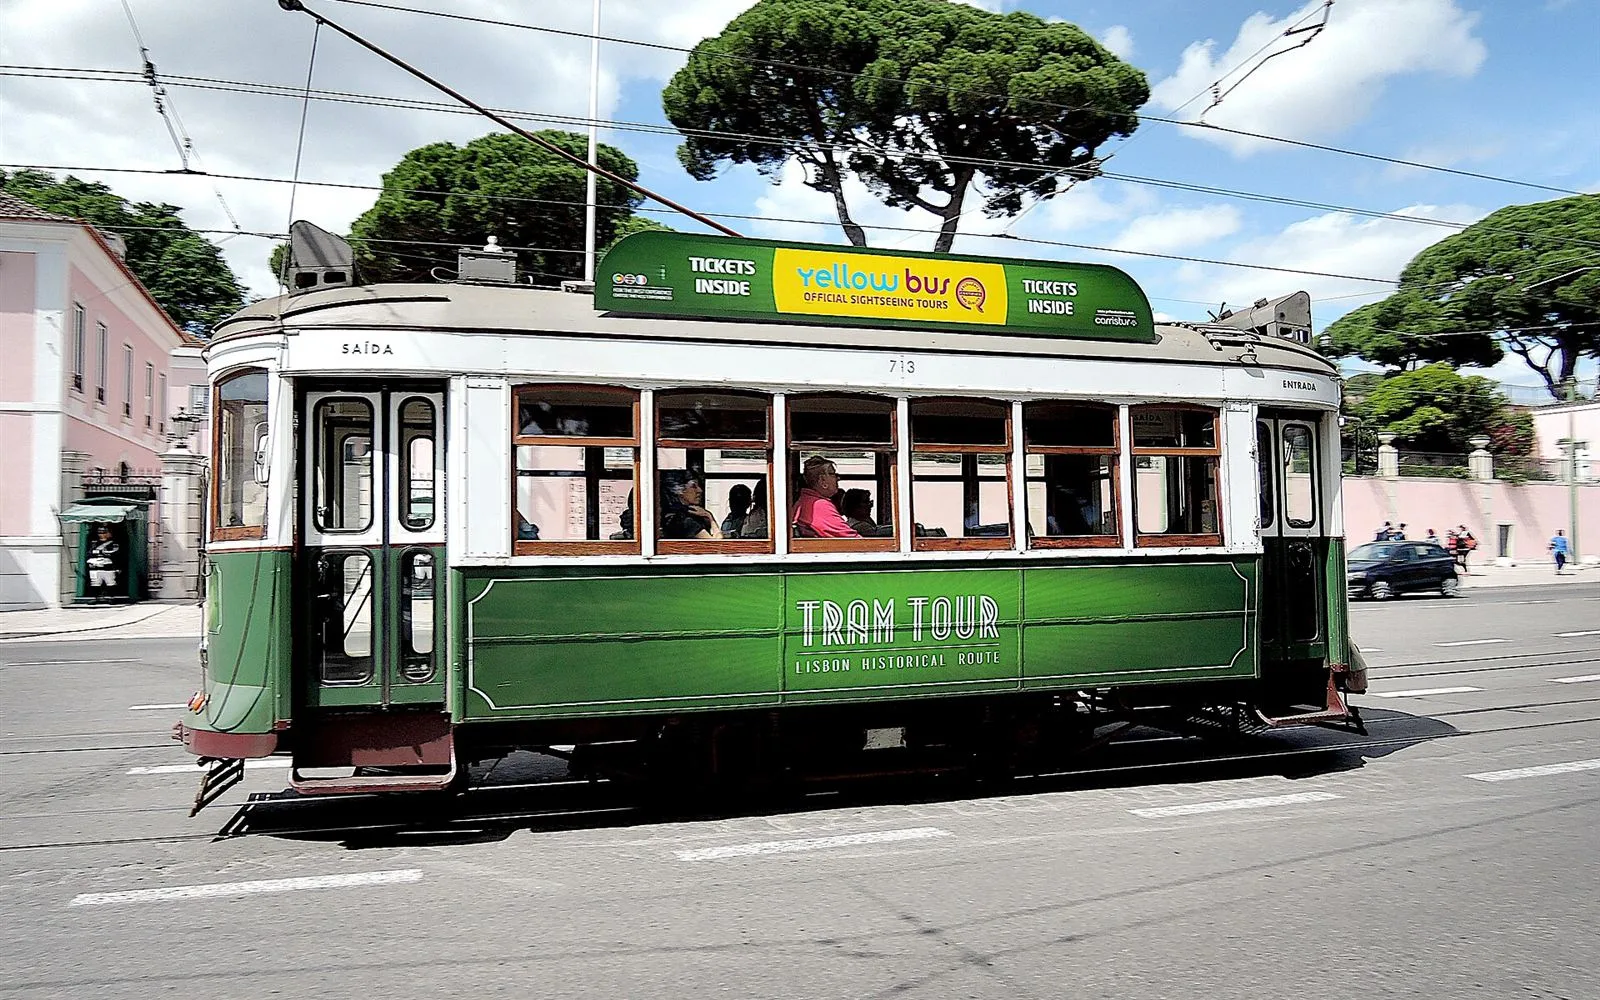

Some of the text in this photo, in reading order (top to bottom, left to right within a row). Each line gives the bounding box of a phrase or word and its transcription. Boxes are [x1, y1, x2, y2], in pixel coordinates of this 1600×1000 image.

[689, 257, 756, 275] TICKETS
[695, 279, 750, 296] INSIDE
[905, 268, 950, 295] bus
[1022, 280, 1077, 296] TICKETS
[804, 292, 848, 304] OFFICIAL
[851, 295, 914, 308] SIGHTSEEING
[916, 299, 948, 309] TOURS
[1028, 300, 1073, 315] INSIDE
[342, 340, 394, 355] SAÍDA
[890, 360, 915, 373] 713
[1282, 380, 1317, 392] ENTRADA
[796, 595, 999, 647] TRAM TOUR
[796, 651, 1000, 674] LISBON HISTORICAL ROUTE
